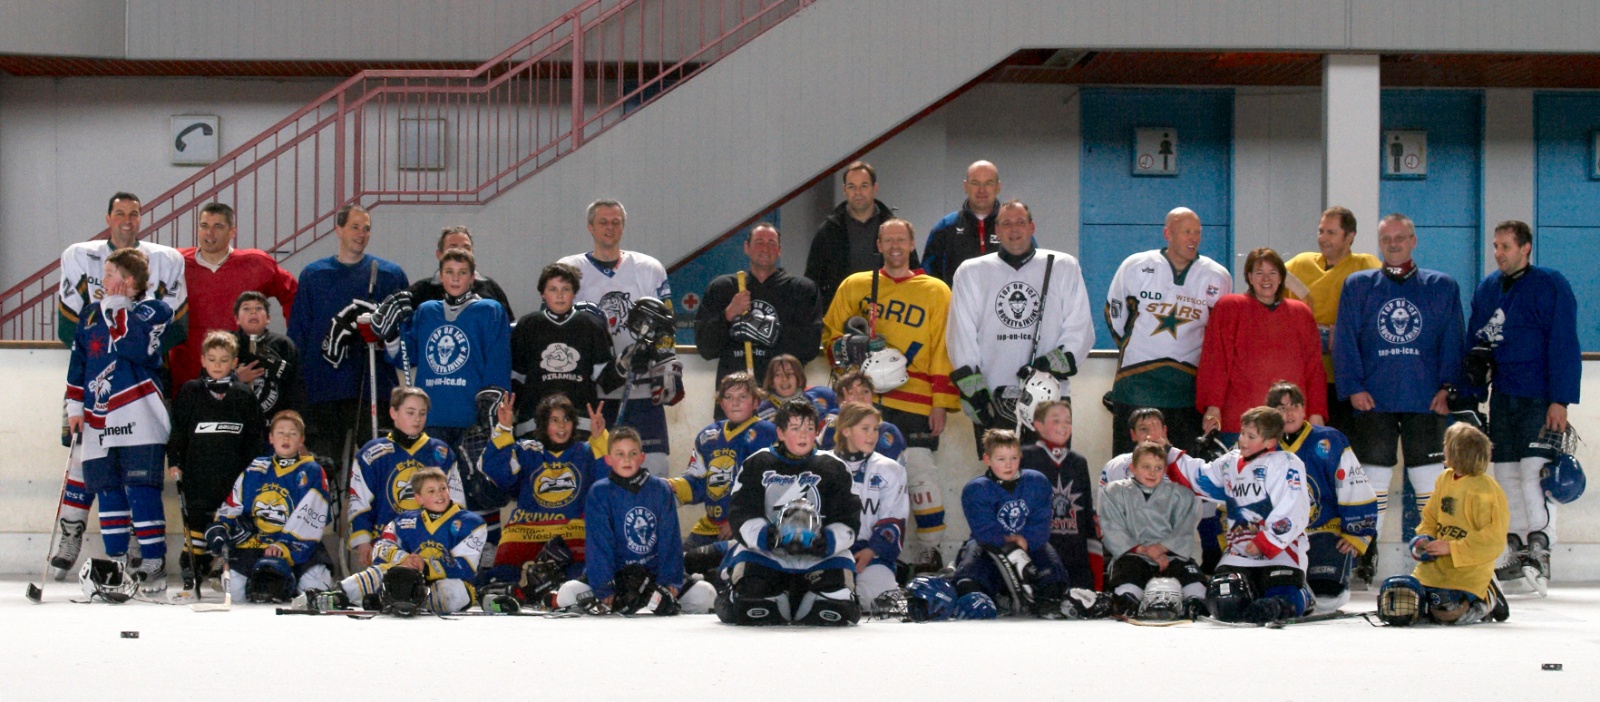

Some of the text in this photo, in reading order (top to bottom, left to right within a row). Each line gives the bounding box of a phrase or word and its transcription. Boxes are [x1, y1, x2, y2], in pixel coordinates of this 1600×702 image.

[88, 276, 102, 286] OL
[999, 286, 1011, 298] TOP
[1026, 286, 1037, 298] ICE
[1140, 290, 1208, 306] OLD WIESLOC
[1145, 302, 1203, 320] STARS
[430, 329, 442, 343] TOP
[454, 330, 466, 344] ICE
[542, 373, 583, 382] PIRANHAS
[713, 449, 736, 458] EHC
[798, 472, 821, 488] Bay
[262, 482, 289, 497] EHC
